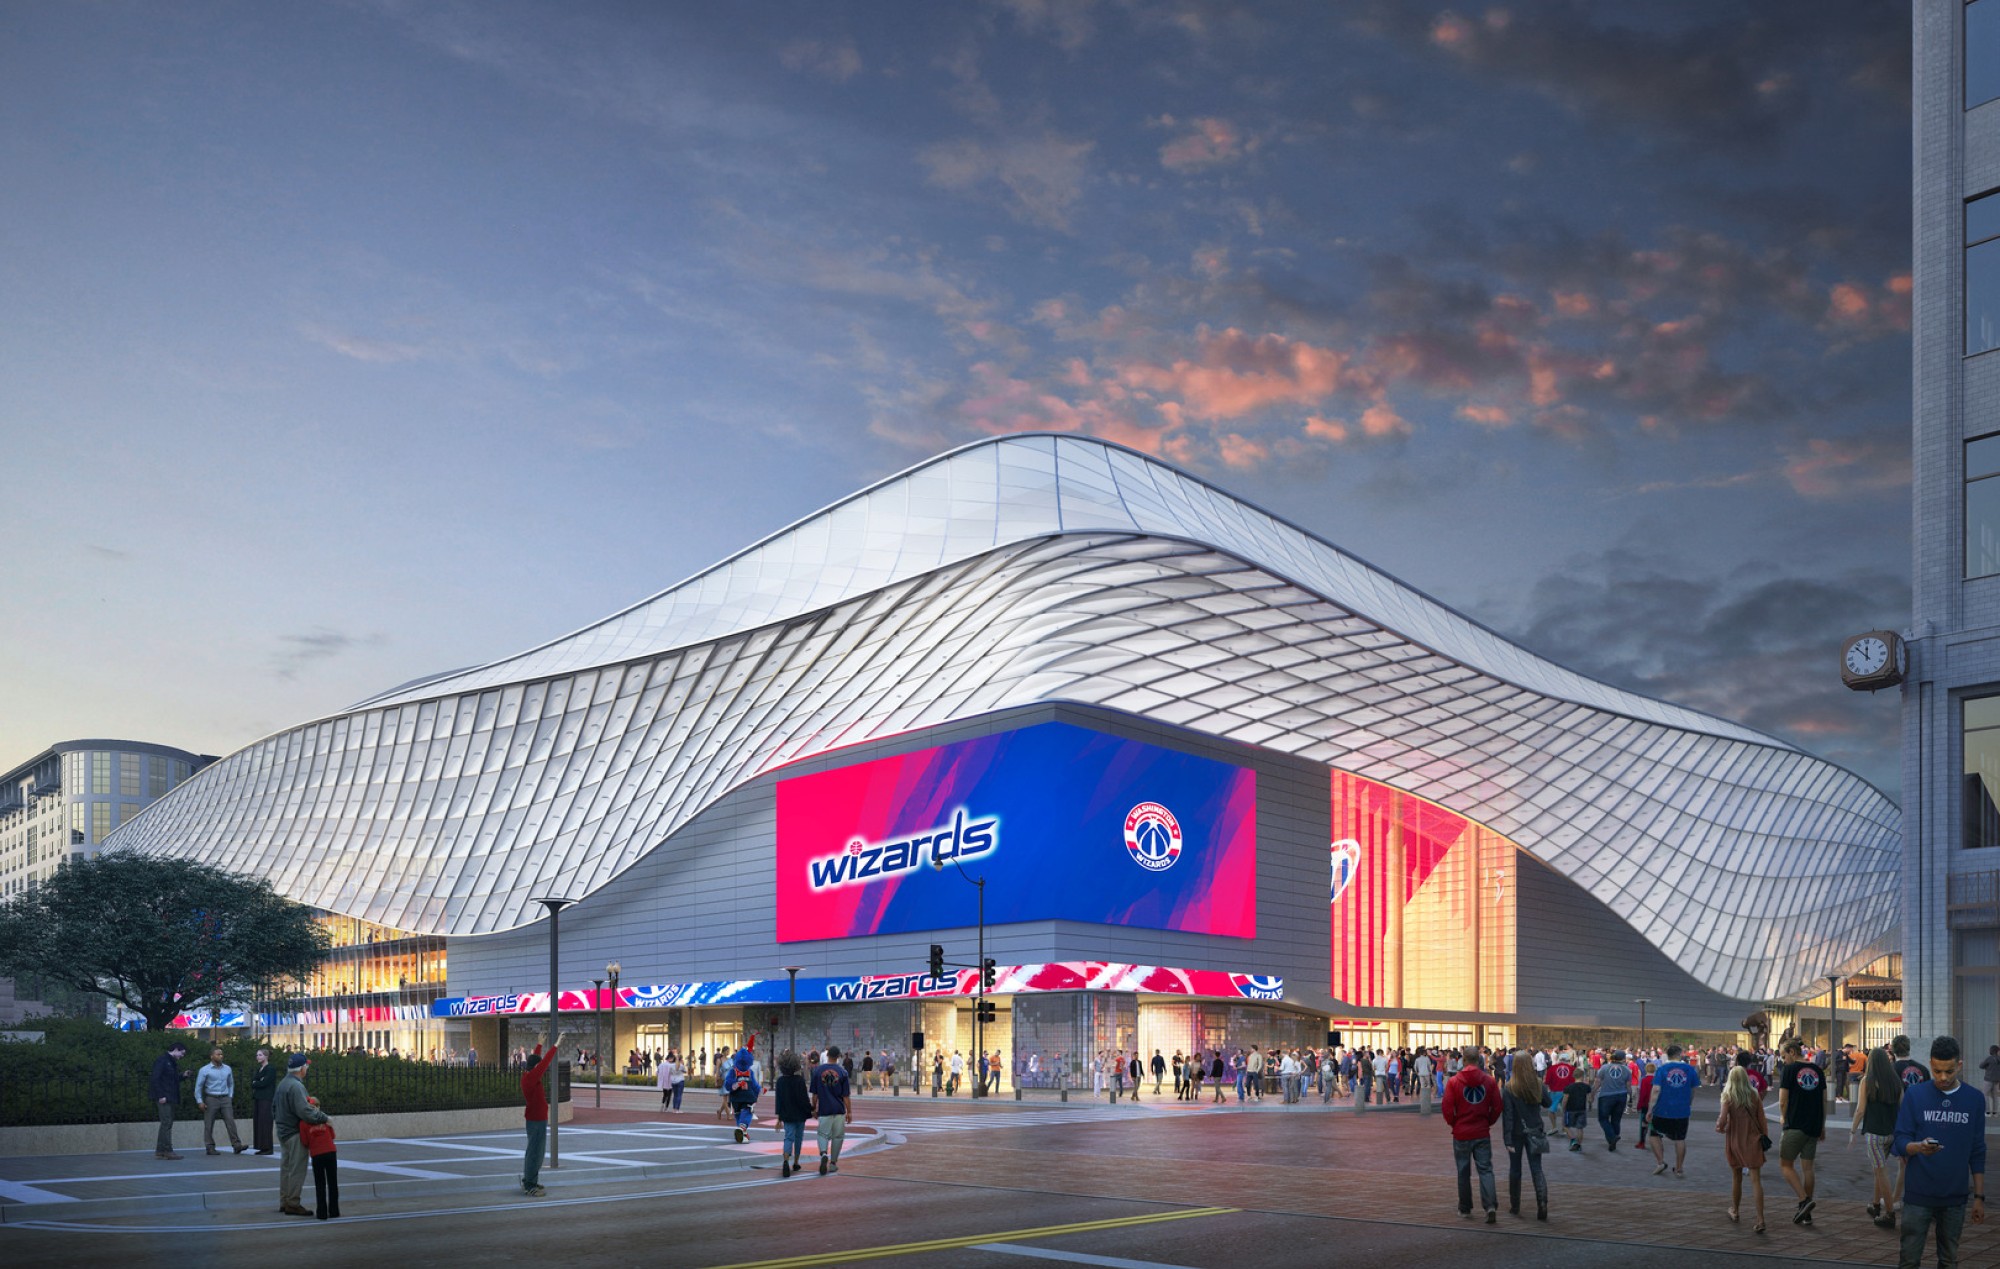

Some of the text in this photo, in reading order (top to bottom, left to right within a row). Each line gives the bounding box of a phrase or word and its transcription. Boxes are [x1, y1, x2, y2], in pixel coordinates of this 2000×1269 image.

[1130, 804, 1176, 827] WASHINGTON
[811, 810, 997, 888] wizards
[1136, 851, 1172, 868] WIZARDS
[450, 995, 518, 1015] wizards
[635, 984, 680, 1007] WIZARDS
[1923, 1110, 1969, 1124] WIZARDS
